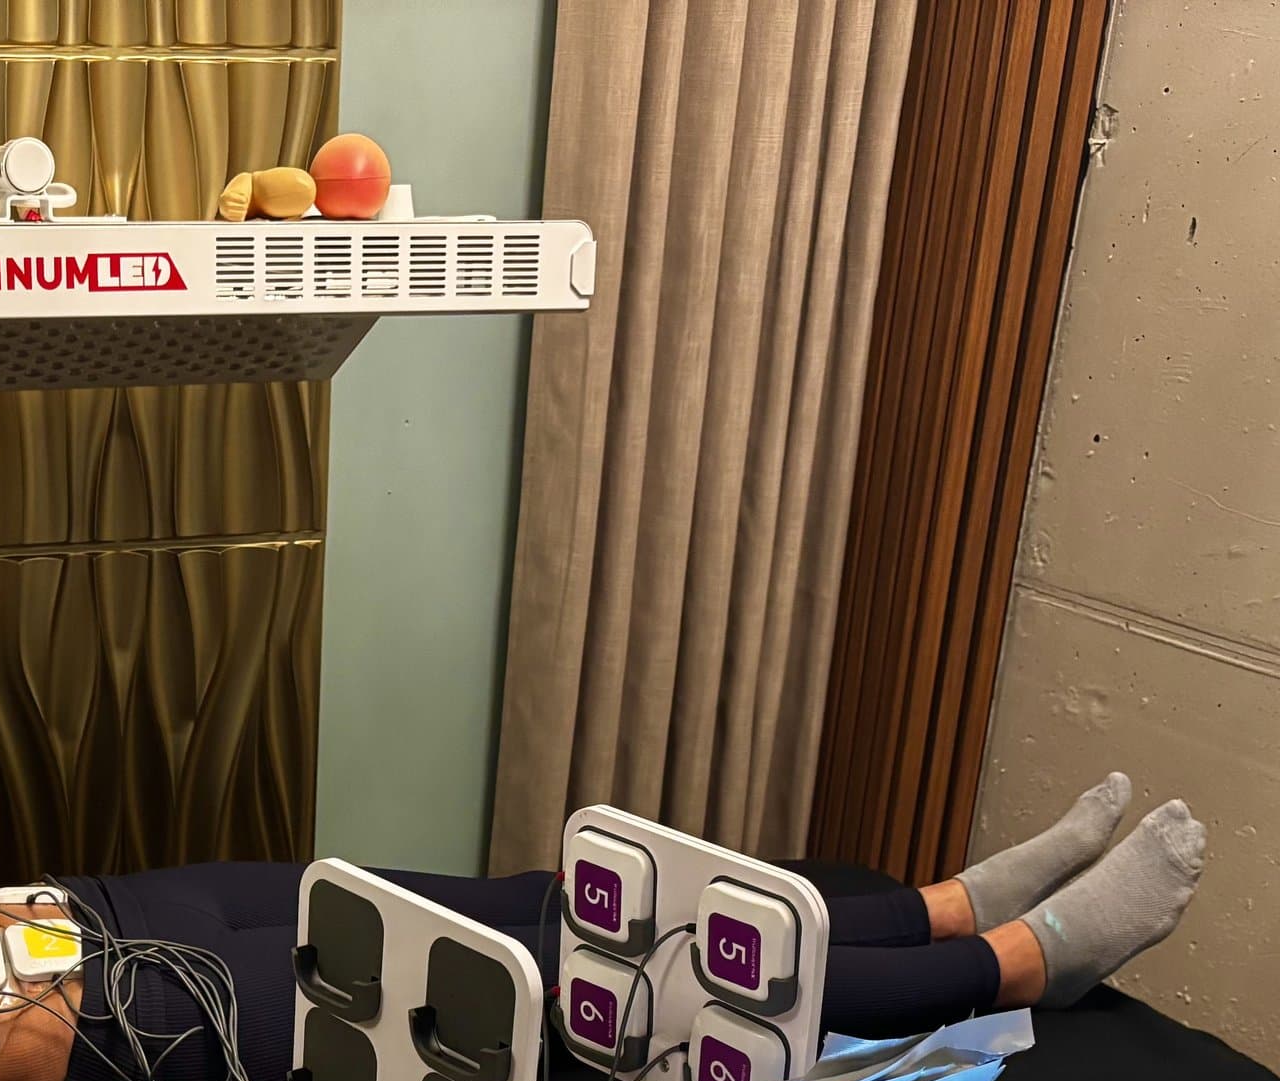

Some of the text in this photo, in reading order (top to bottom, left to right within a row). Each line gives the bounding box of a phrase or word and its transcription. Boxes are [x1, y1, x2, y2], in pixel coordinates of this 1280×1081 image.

[584, 882, 608, 909] 5
[41, 934, 60, 951] 2
[719, 937, 747, 965] 5
[580, 1000, 604, 1023] 6
